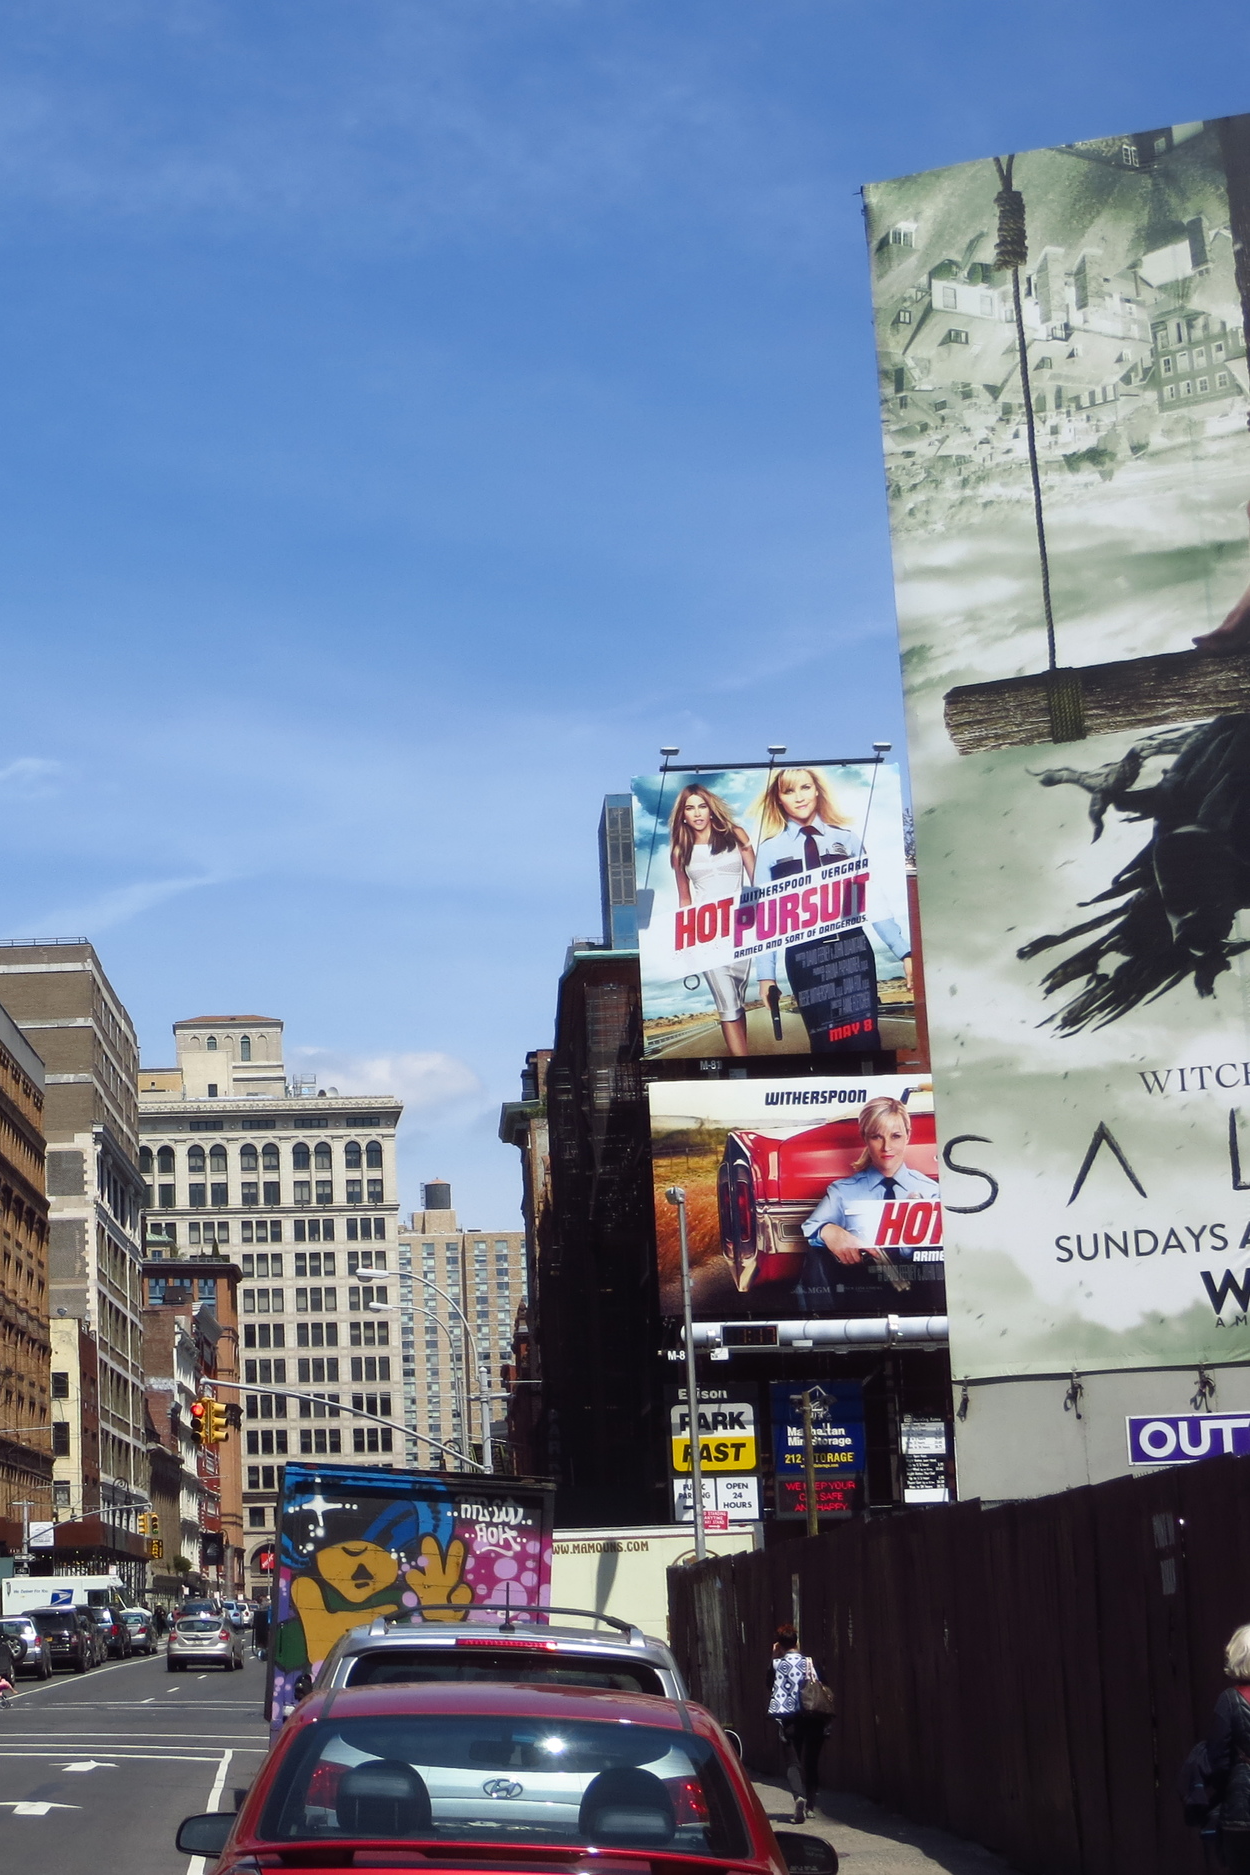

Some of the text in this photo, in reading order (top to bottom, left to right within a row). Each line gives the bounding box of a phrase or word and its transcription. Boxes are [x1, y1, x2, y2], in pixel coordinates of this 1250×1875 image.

[739, 857, 869, 905] WITHERSPOON VERGARA
[674, 871, 870, 951] HOT PURSUIT
[734, 944, 764, 959] ARMED
[766, 938, 783, 950] AND
[785, 932, 805, 945] SORT
[807, 928, 817, 939] OF
[829, 1021, 861, 1042] MAY
[863, 1018, 874, 1032] 8
[765, 1089, 867, 1106] WITHERSPOON
[1054, 1223, 1229, 1263] SUNDAYS
[678, 1388, 728, 1400] Eison
[787, 1422, 846, 1437] Mahattan
[784, 1452, 855, 1464] 212-TORAGE
[726, 1482, 749, 1490] OPEN
[829, 1480, 856, 1490] YOUR
[819, 1491, 844, 1500] SAFE
[723, 1501, 753, 1509] HOURS
